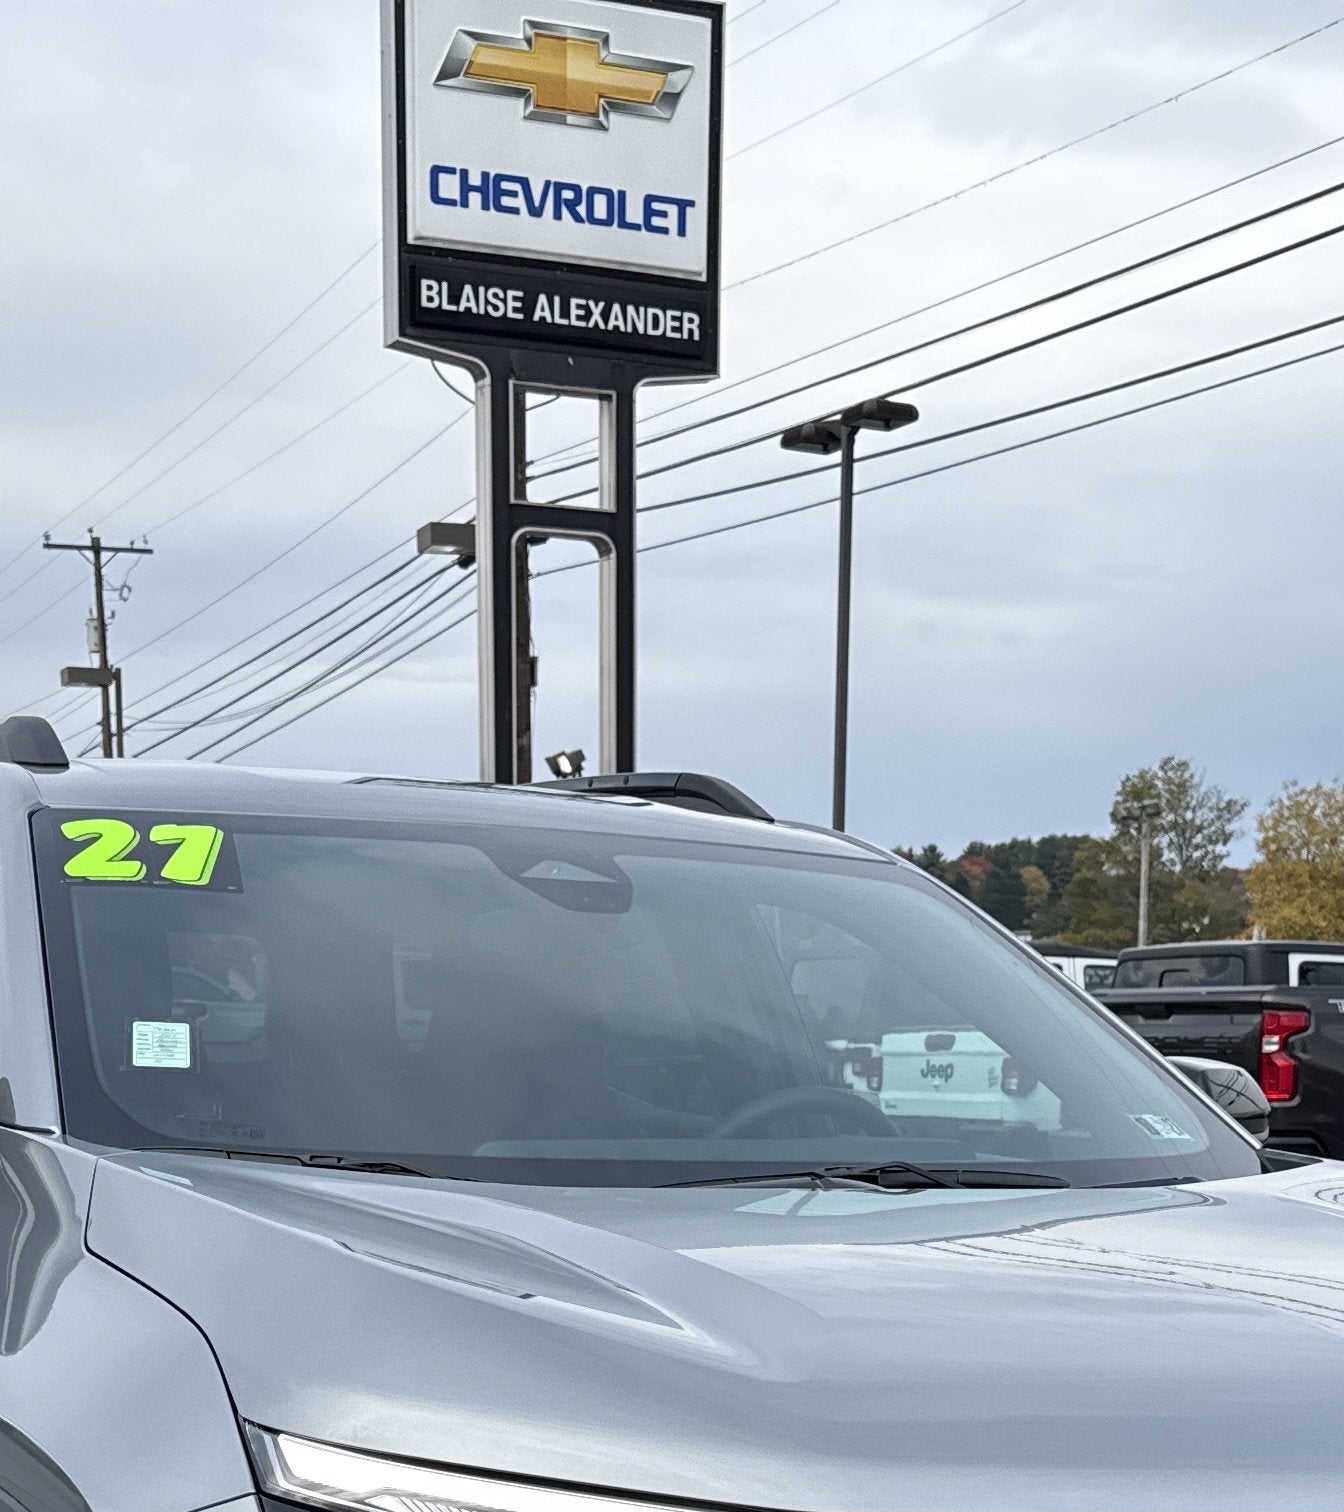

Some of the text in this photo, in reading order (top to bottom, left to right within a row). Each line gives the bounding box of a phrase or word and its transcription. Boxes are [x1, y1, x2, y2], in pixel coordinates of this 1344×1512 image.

[429, 164, 696, 237] CHEVROLET
[420, 278, 701, 341] BLAISE ALEXANDER
[60, 818, 224, 885] 27
[920, 1059, 954, 1083] Jeep
